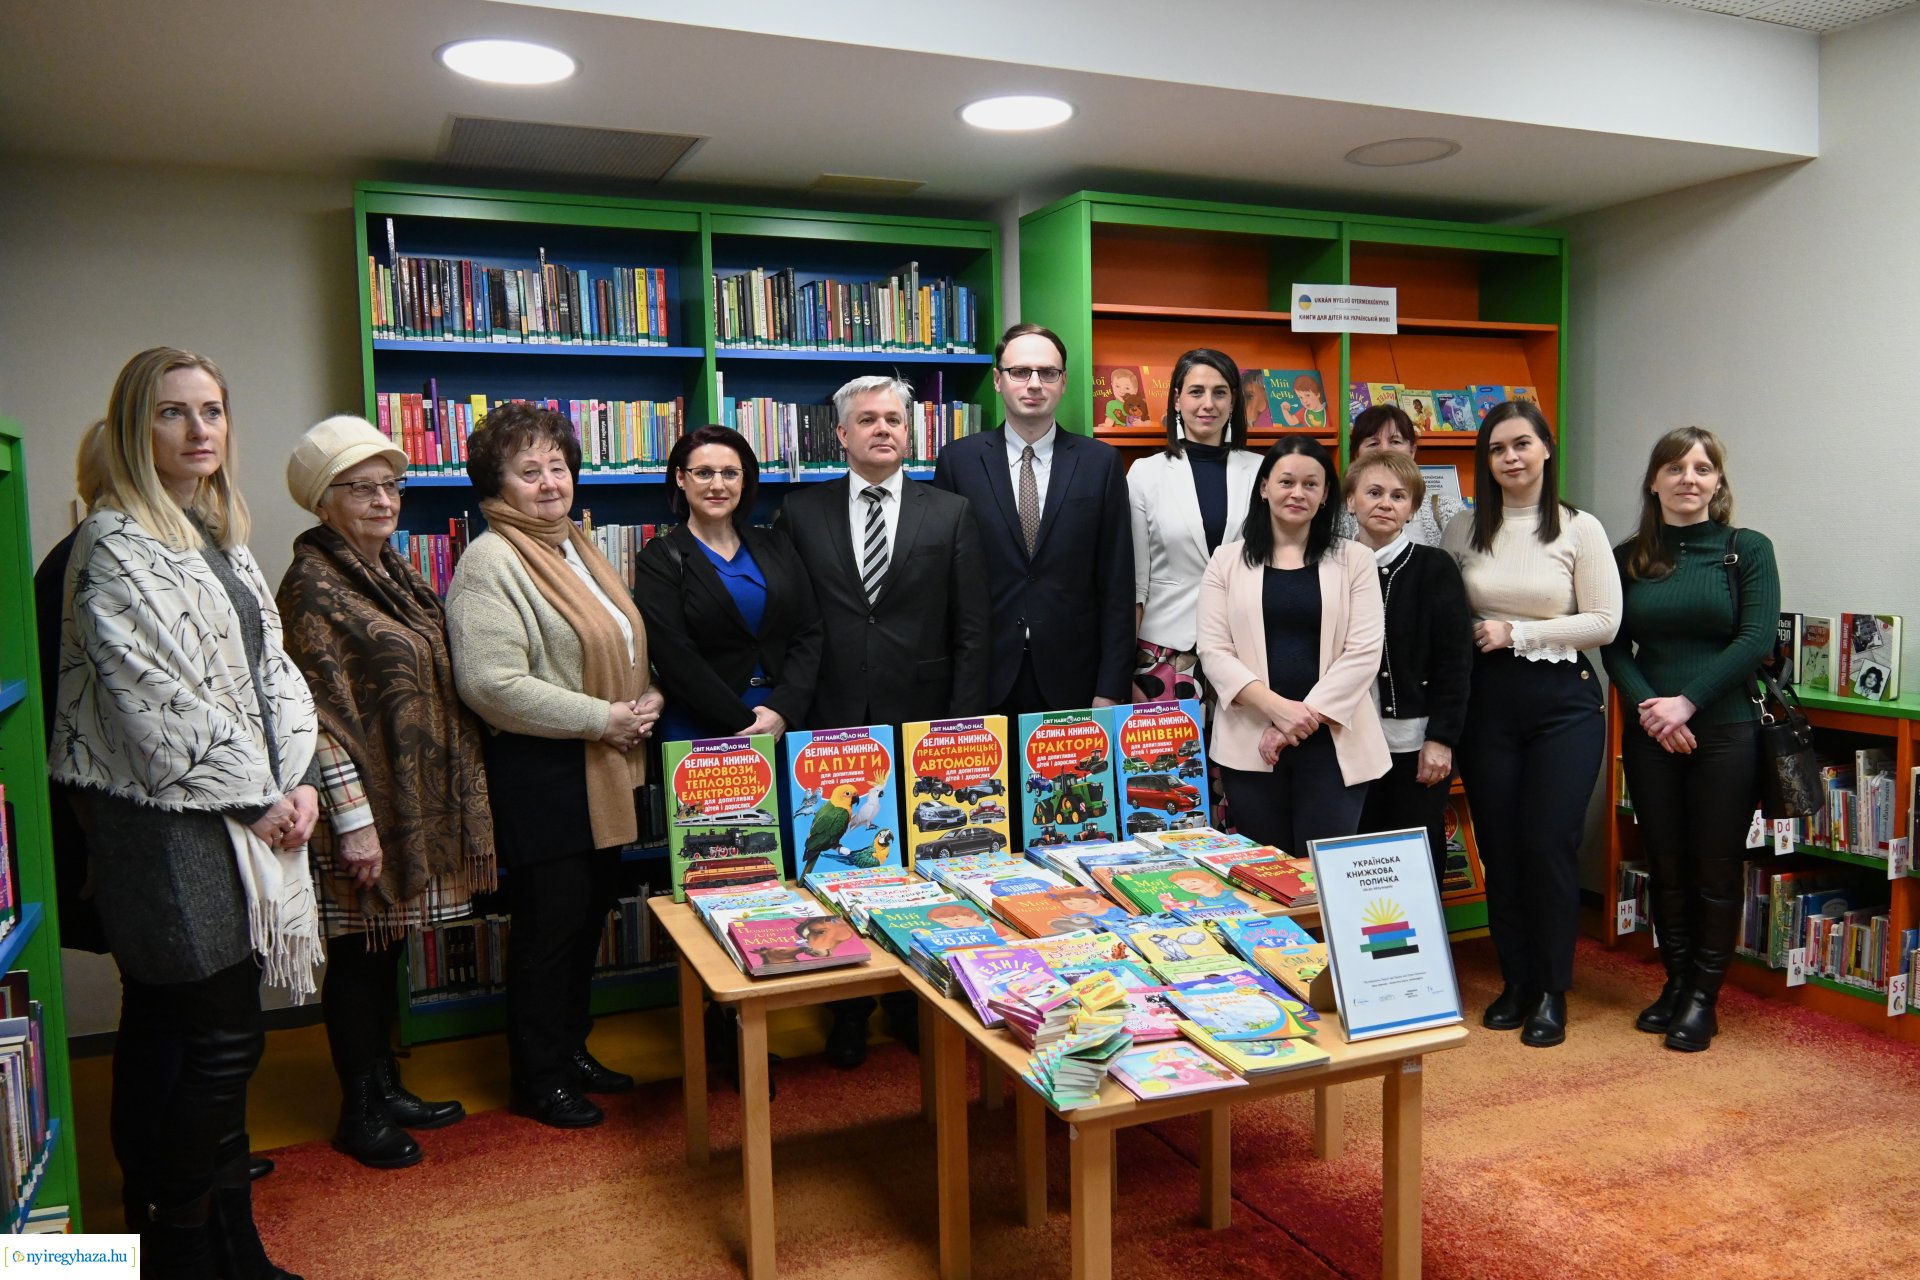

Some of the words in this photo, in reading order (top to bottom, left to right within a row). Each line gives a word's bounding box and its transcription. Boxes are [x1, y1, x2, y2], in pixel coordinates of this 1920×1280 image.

[1093, 377, 1105, 385] ої
[1270, 379, 1289, 388] Мій
[1128, 718, 1156, 728] ВЕЛИКА
[1159, 716, 1189, 725] КНИЖКА
[1036, 729, 1065, 739] ВЕЛИКА
[1068, 726, 1099, 736] КНИЖКА
[1126, 726, 1193, 743] МІНІВЕНИ
[923, 737, 955, 747] ВЕЛИКА
[958, 734, 992, 744] КНИЖКА
[1031, 737, 1103, 754] ТРАКТОРИ
[805, 746, 839, 757] ВЕЛИКА
[842, 743, 879, 754] КНИЖКА
[917, 741, 997, 757] ПРЕДСТАВНИЦЬКІ
[685, 757, 720, 768] ВЕЛИКА
[723, 754, 760, 765] КНИЖКА
[804, 754, 881, 773] ПАПУГИ
[920, 752, 998, 771] АВТОМОБІЛІ
[689, 765, 756, 778] ПАРОВОЗИ,
[686, 775, 760, 789] ТЕПЛОВОЗИ,
[682, 785, 765, 800] ЕЛЕКТРОВОЗИ
[725, 803, 750, 811] дорослих
[1777, 822, 1783, 834] D
[1786, 820, 1790, 832] d
[1892, 844, 1898, 855] M
[1900, 846, 1906, 855] m
[1352, 856, 1400, 868] УКРАЇНСЬКА
[1346, 867, 1393, 879] КНИЖКОВА
[1359, 875, 1399, 887] ПОЛИЧКА
[1621, 905, 1626, 915] H
[1628, 903, 1632, 914] h
[885, 912, 920, 921] Мій
[1792, 954, 1797, 965] L
[1893, 980, 1898, 993] S
[1900, 982, 1905, 991] s
